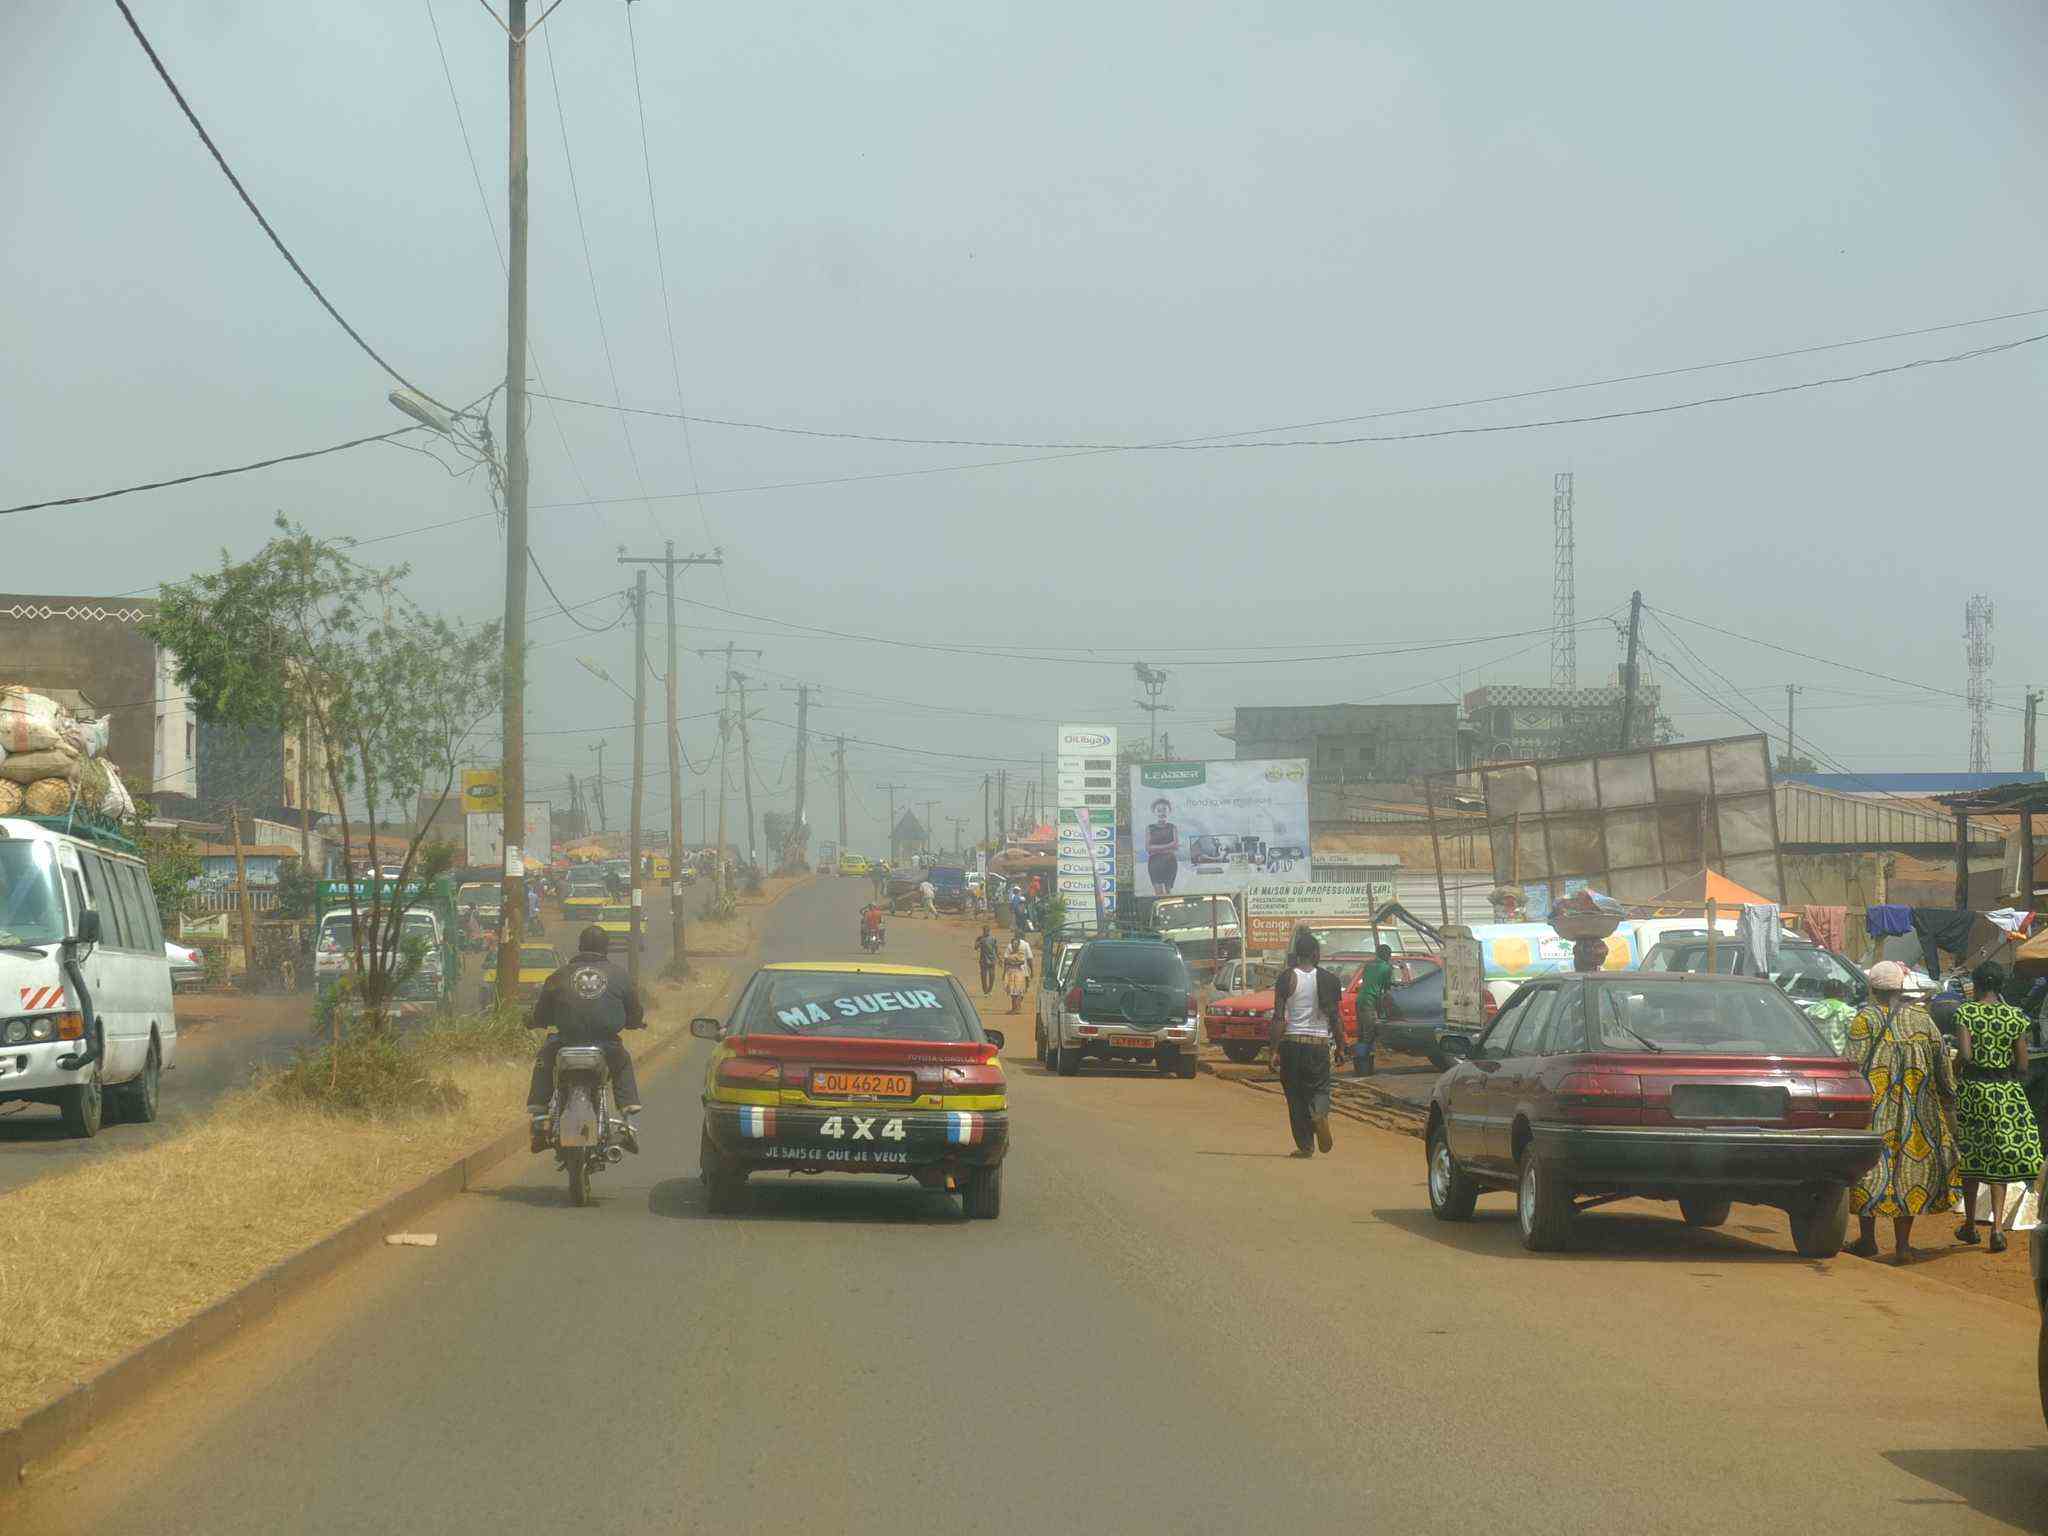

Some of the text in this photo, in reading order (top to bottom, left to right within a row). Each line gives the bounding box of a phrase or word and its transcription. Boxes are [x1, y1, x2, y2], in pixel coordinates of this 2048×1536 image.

[1262, 886, 1290, 896] MAISON
[1305, 885, 1371, 896] PROFESSIONNE
[1252, 918, 1290, 930] Orange
[776, 990, 943, 1027] MA SUEUR
[852, 1075, 881, 1092] 462
[765, 1147, 908, 1163] JE SAIS CE QUE JE VEUX
